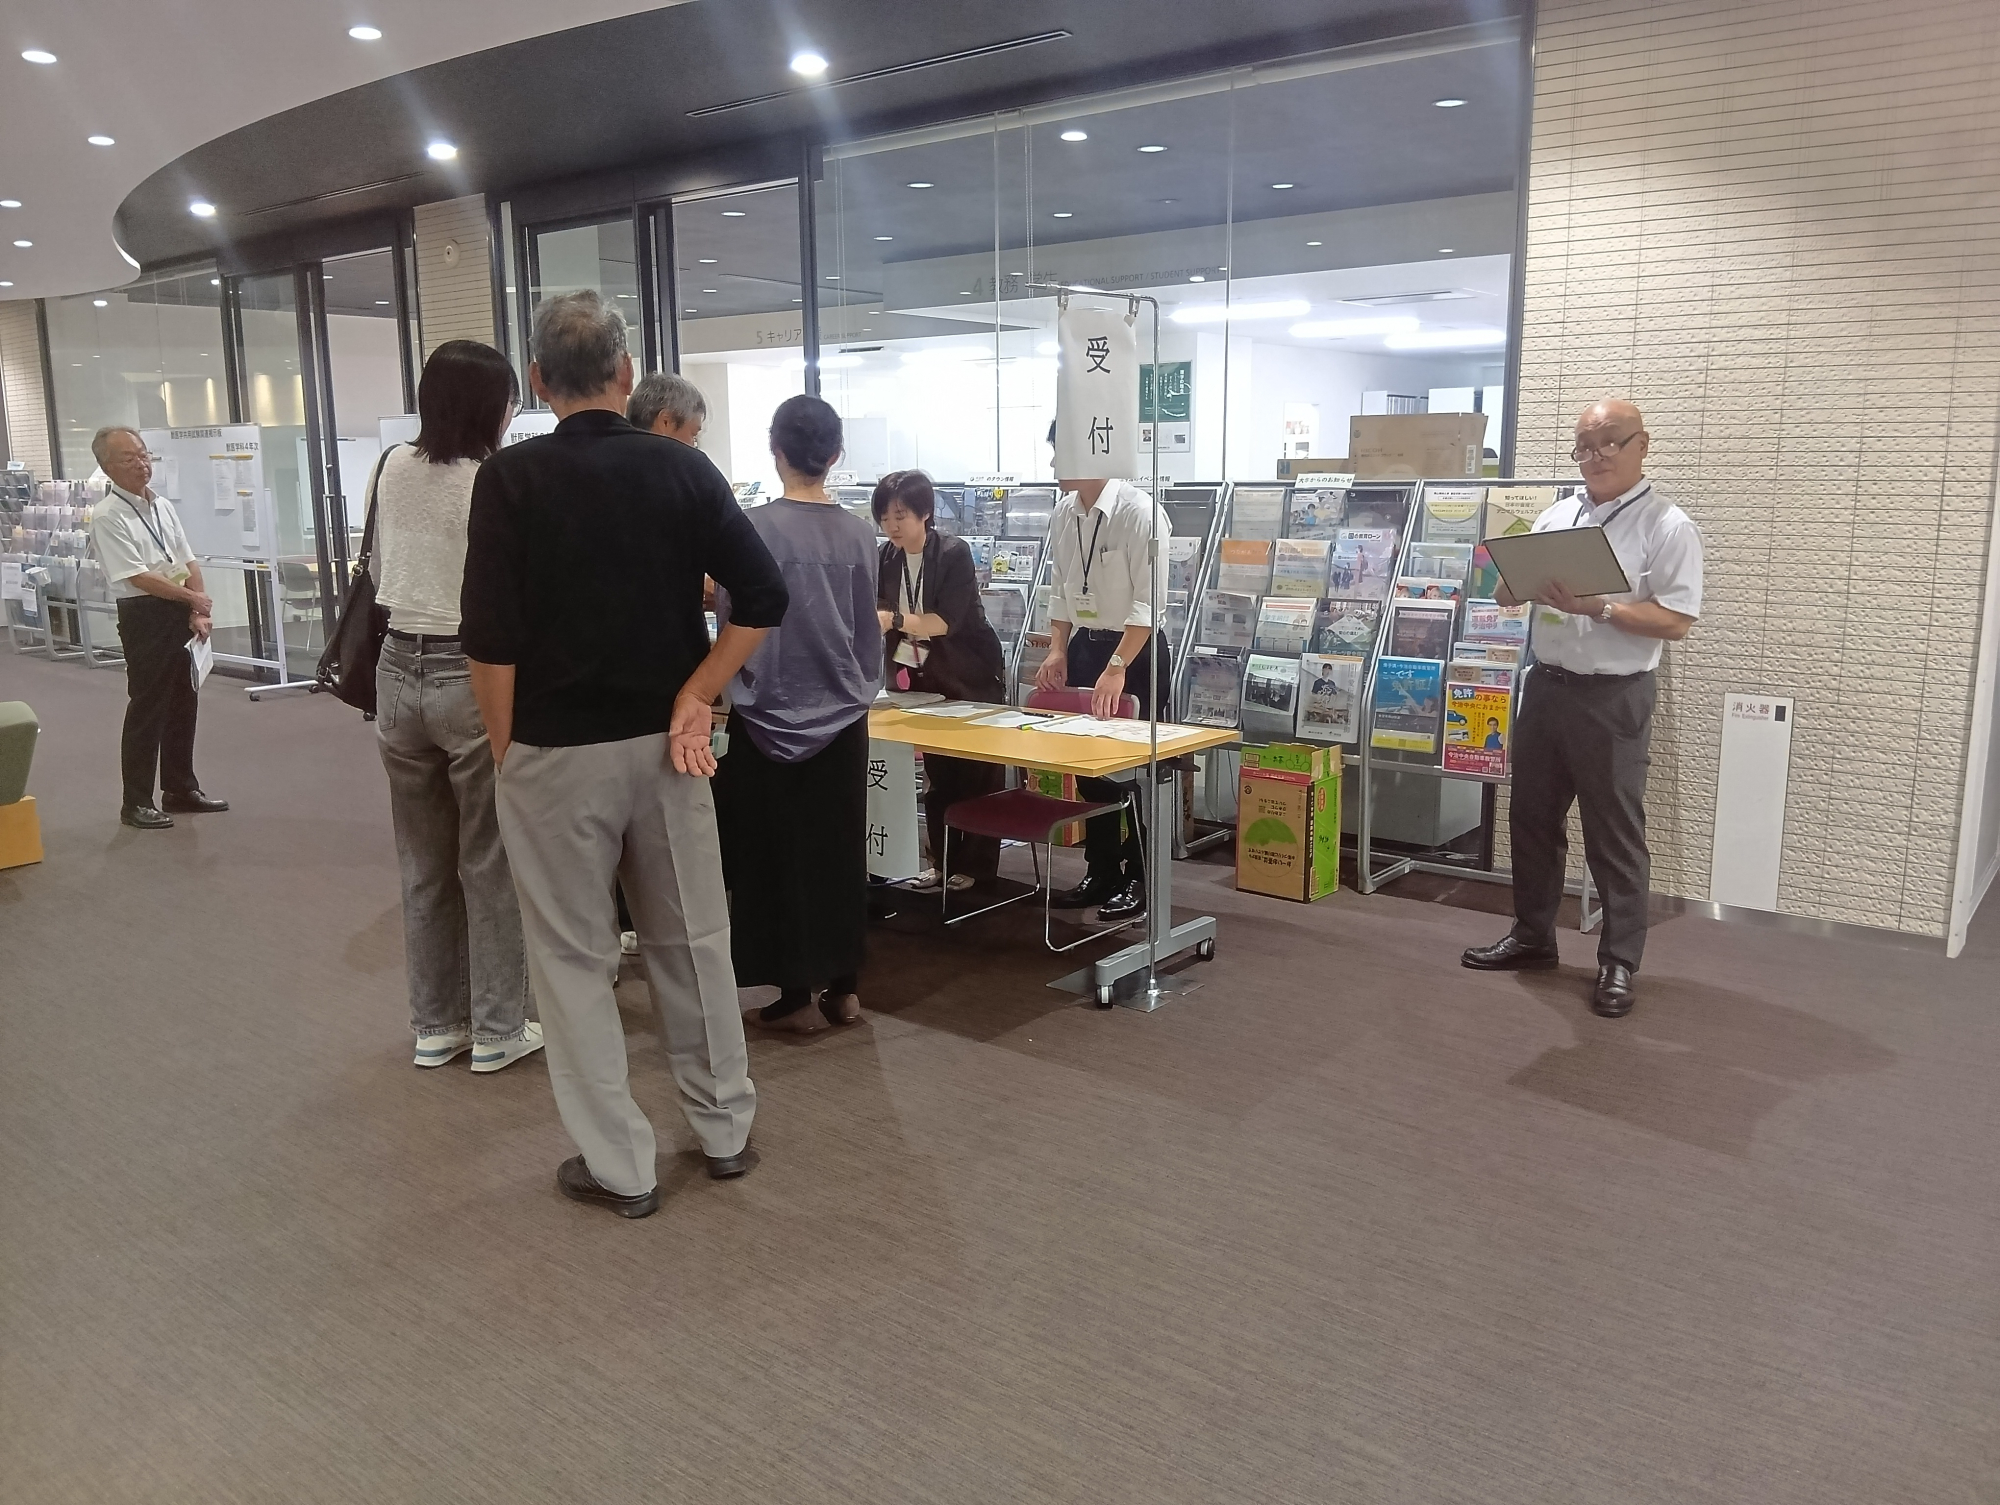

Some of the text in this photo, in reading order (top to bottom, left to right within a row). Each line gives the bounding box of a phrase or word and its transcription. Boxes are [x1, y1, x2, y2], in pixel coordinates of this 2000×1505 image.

[1110, 273, 1143, 284] SUPPORT
[1150, 269, 1184, 280] STUDENT
[756, 331, 763, 344] 5
[1085, 336, 1114, 455] 受付
[226, 442, 259, 452] 獣医学科4年次
[1732, 701, 1770, 715] 消火器
[866, 759, 888, 857] 受付
